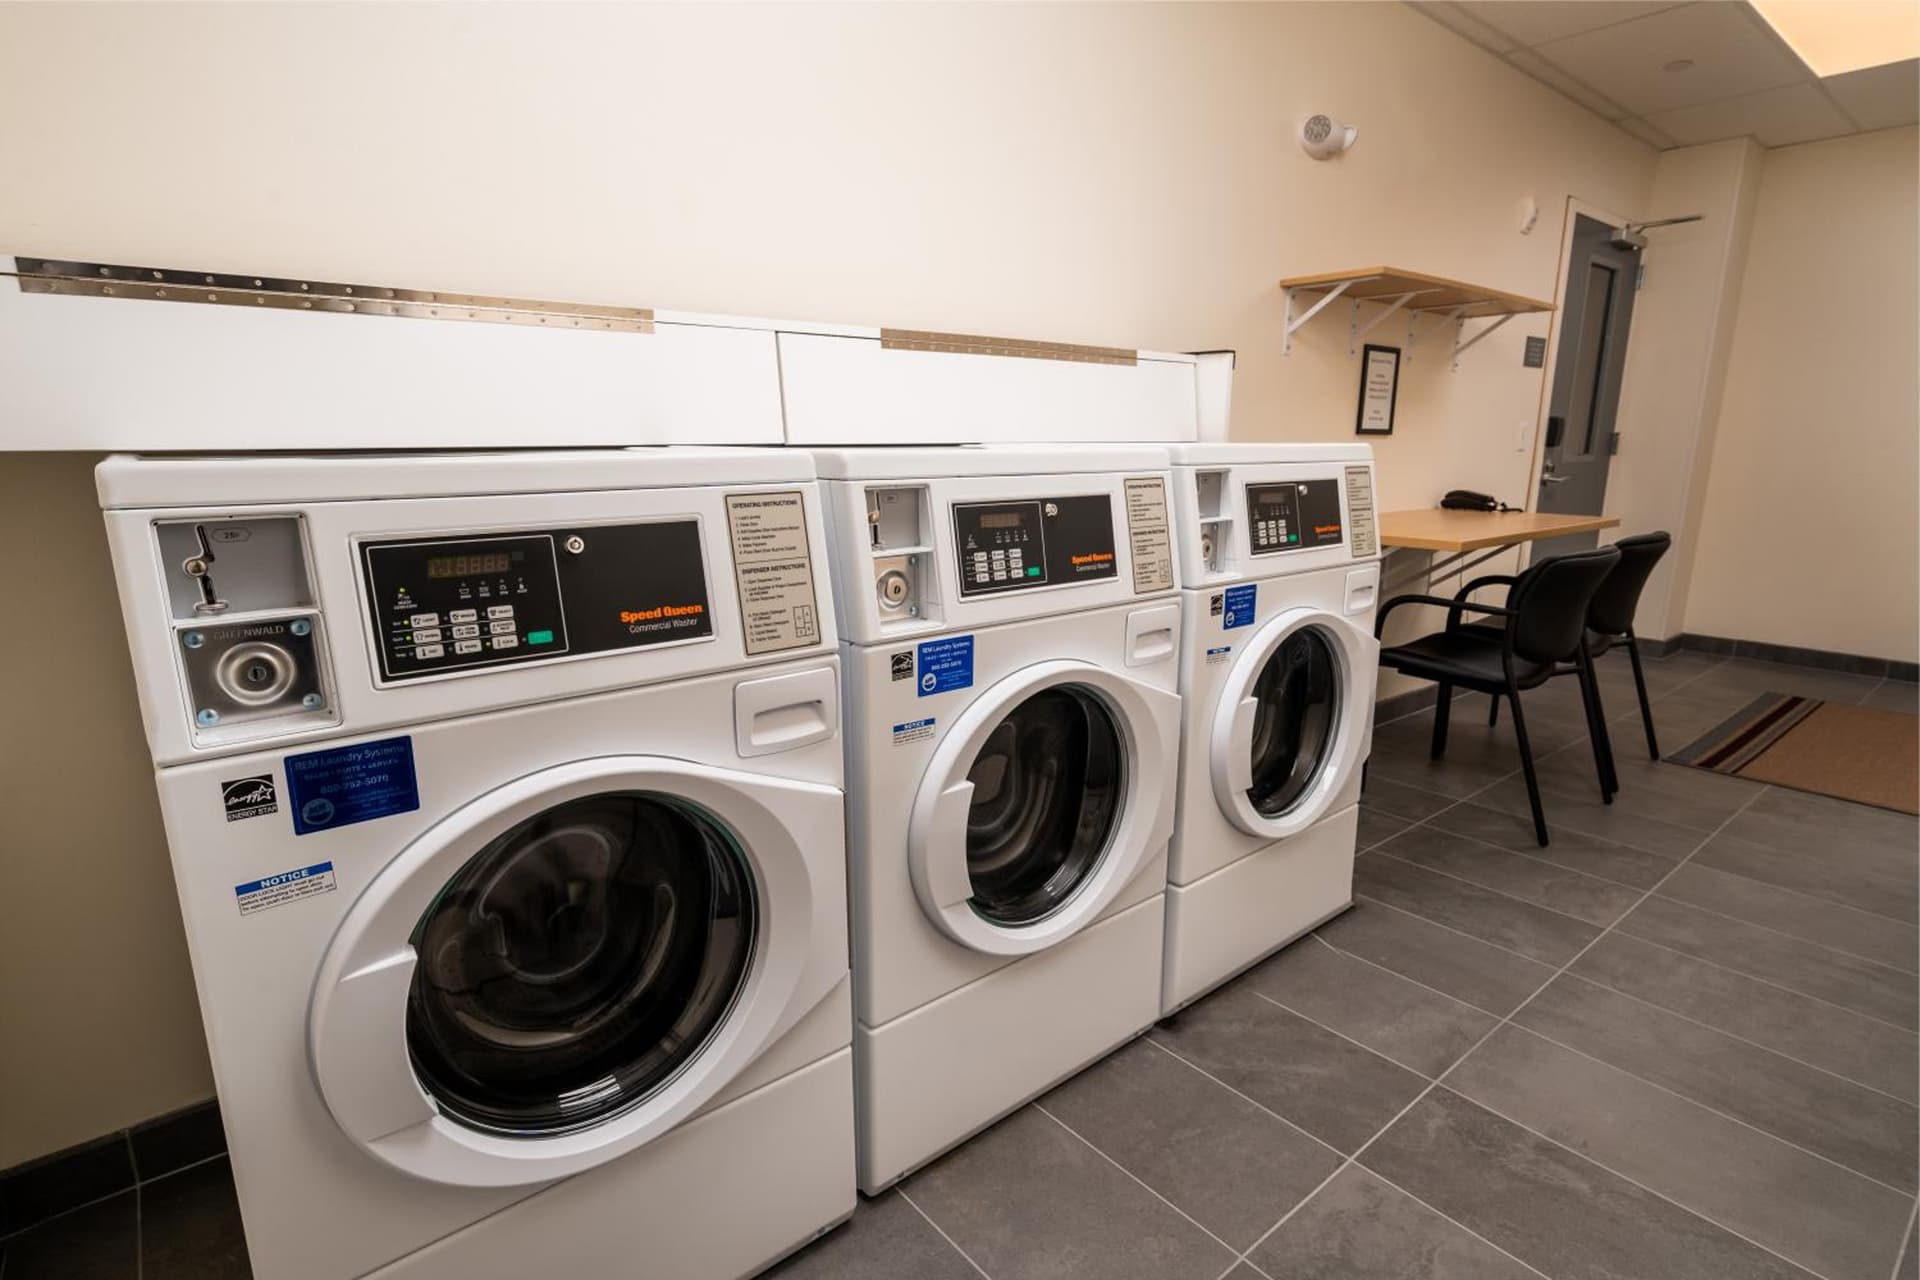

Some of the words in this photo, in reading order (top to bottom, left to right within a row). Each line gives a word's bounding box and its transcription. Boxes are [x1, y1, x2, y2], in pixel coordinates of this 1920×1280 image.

[620, 607, 661, 623] Speed
[663, 604, 703, 617] Queen
[629, 621, 671, 633] Commercial
[673, 618, 697, 629] Washer
[260, 869, 310, 888] NOTICE
